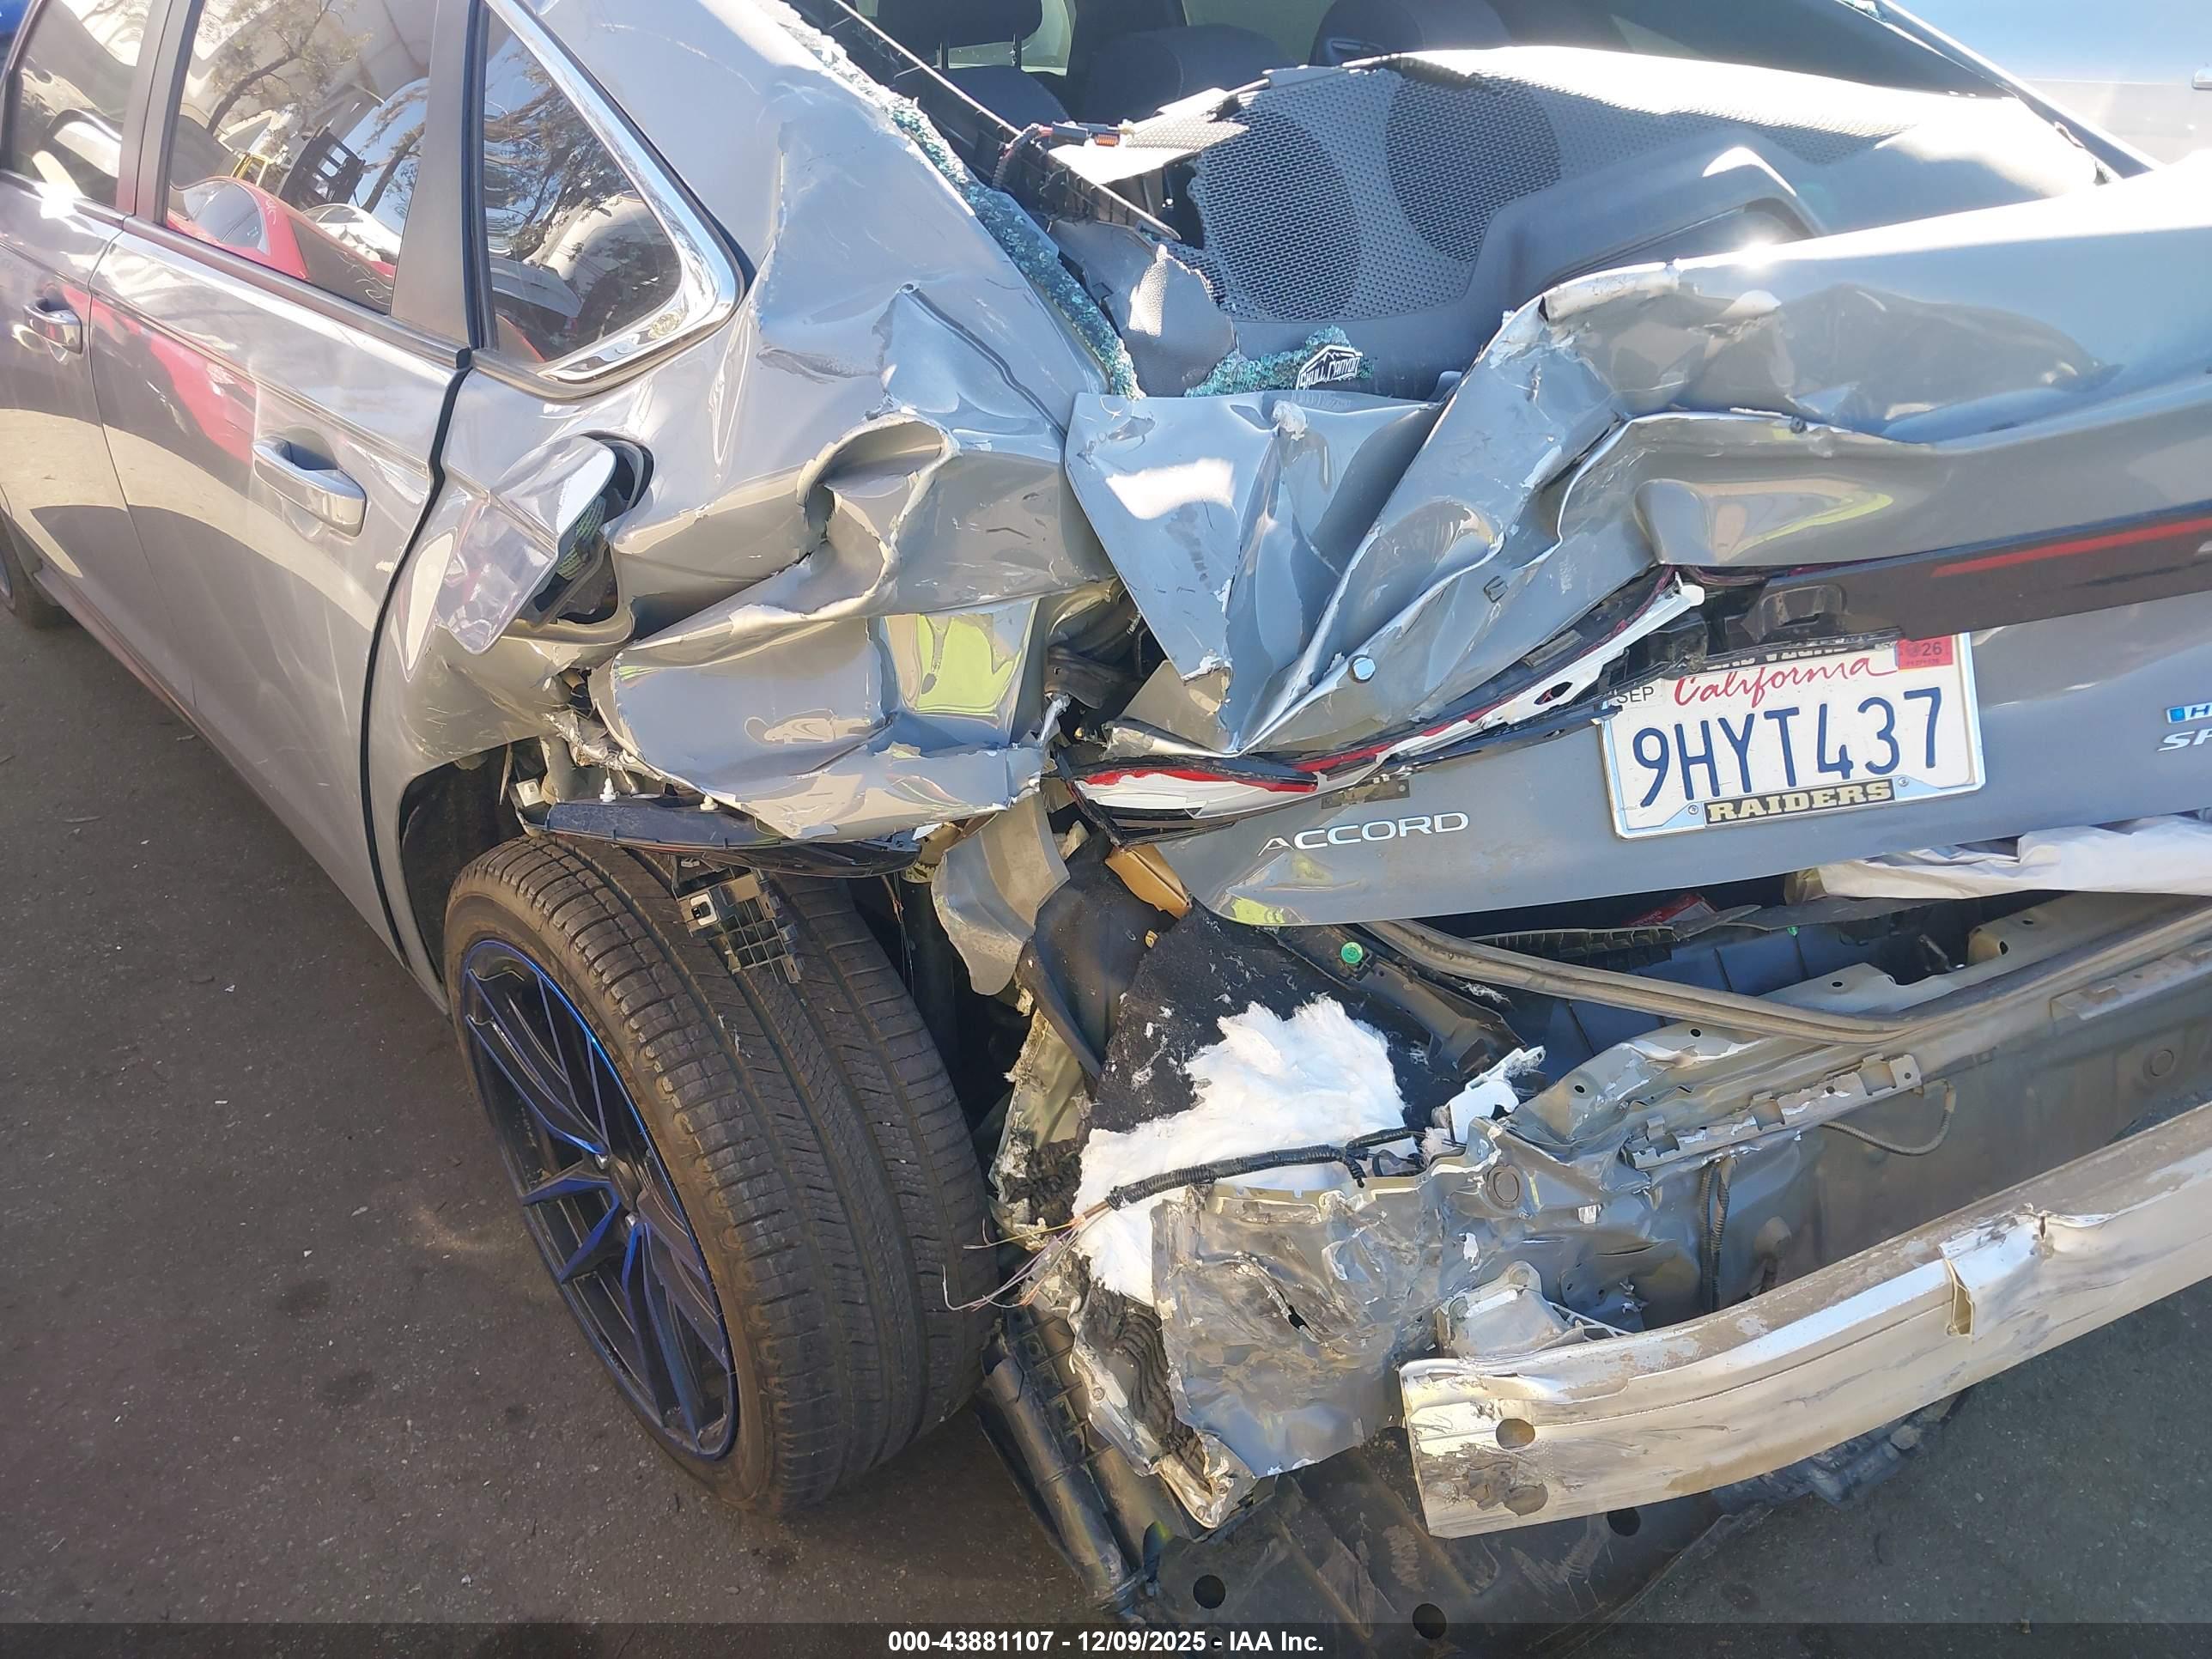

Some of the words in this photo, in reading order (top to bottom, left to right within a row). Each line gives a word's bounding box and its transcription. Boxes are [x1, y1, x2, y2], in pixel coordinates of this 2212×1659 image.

[1922, 641, 1942, 656] 26
[1616, 686, 1655, 704] SEP
[1674, 656, 1898, 708] California
[1632, 686, 1942, 808] 9HYT437
[1706, 781, 1893, 822] RAIDERS
[1257, 811, 1469, 857] ACCORD
